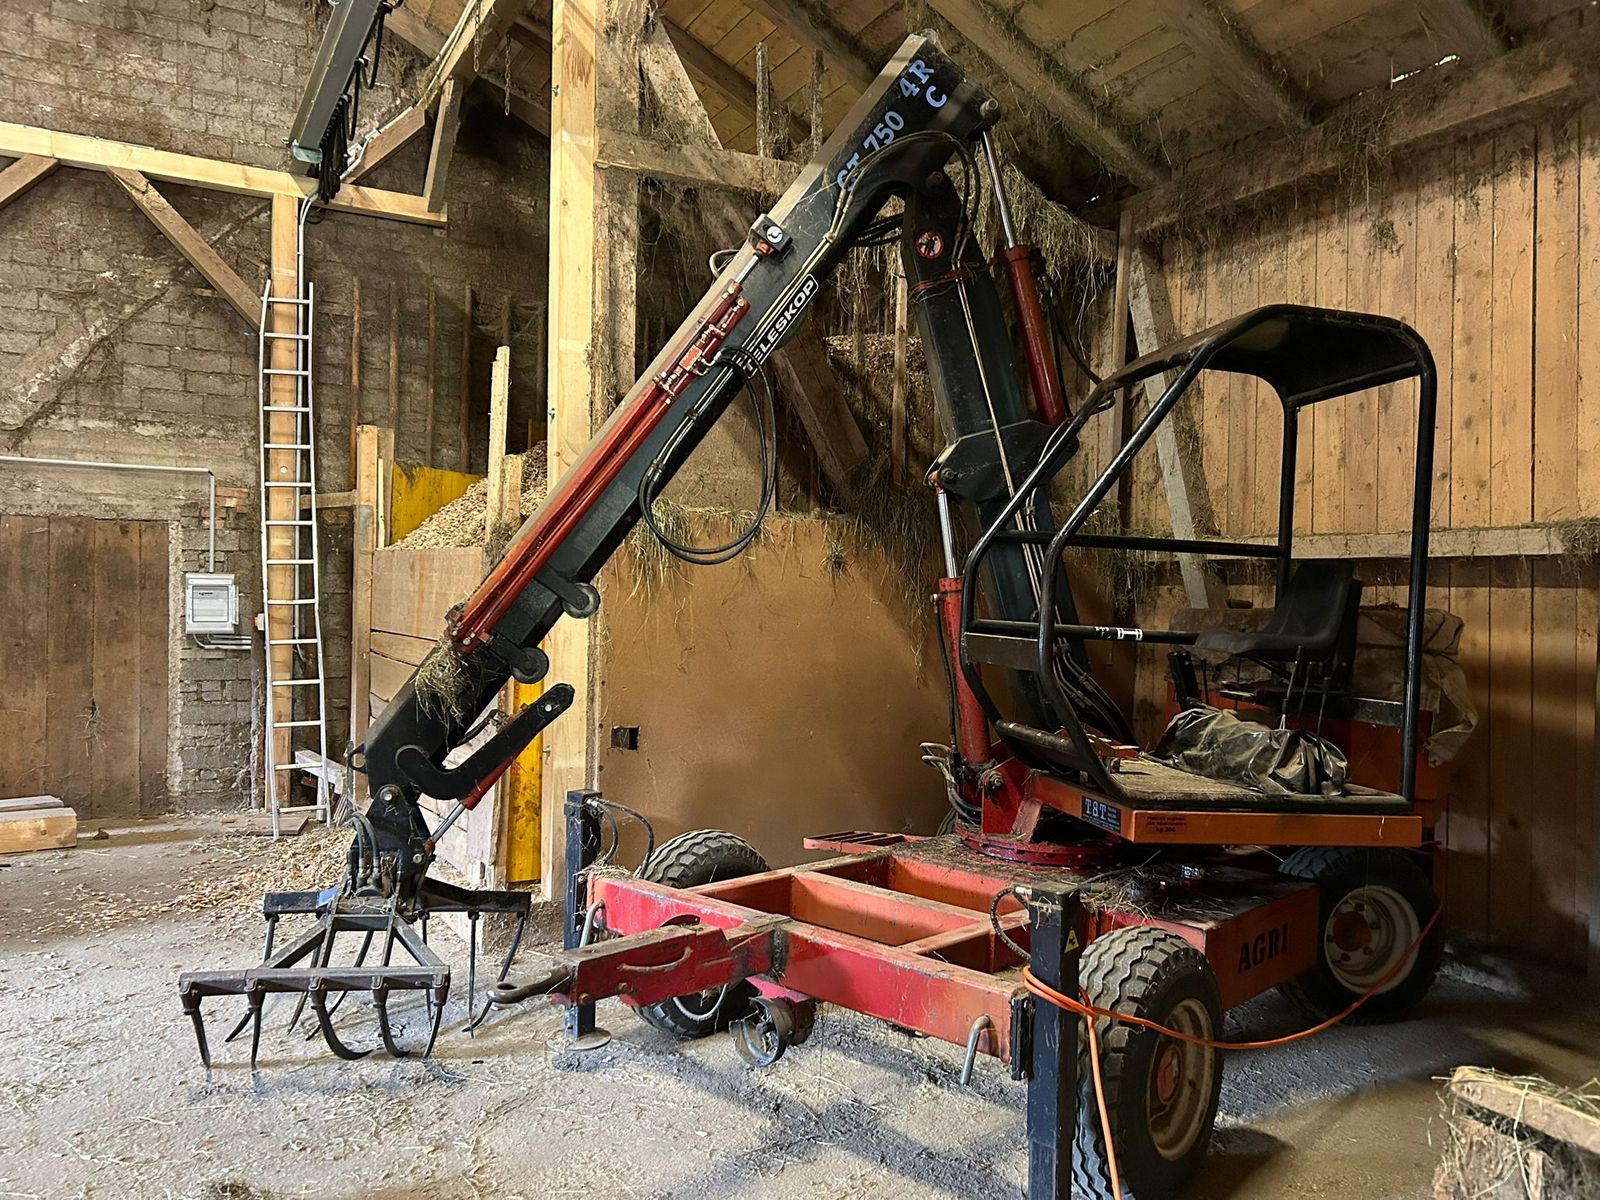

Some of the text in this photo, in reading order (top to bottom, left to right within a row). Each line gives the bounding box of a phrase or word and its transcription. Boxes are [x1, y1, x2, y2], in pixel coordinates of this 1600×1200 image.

[863, 111, 905, 151] 750
[899, 59, 935, 98] 4R
[925, 85, 948, 108] C
[742, 279, 815, 372] TELESKOP
[1237, 922, 1288, 975] AGRI
